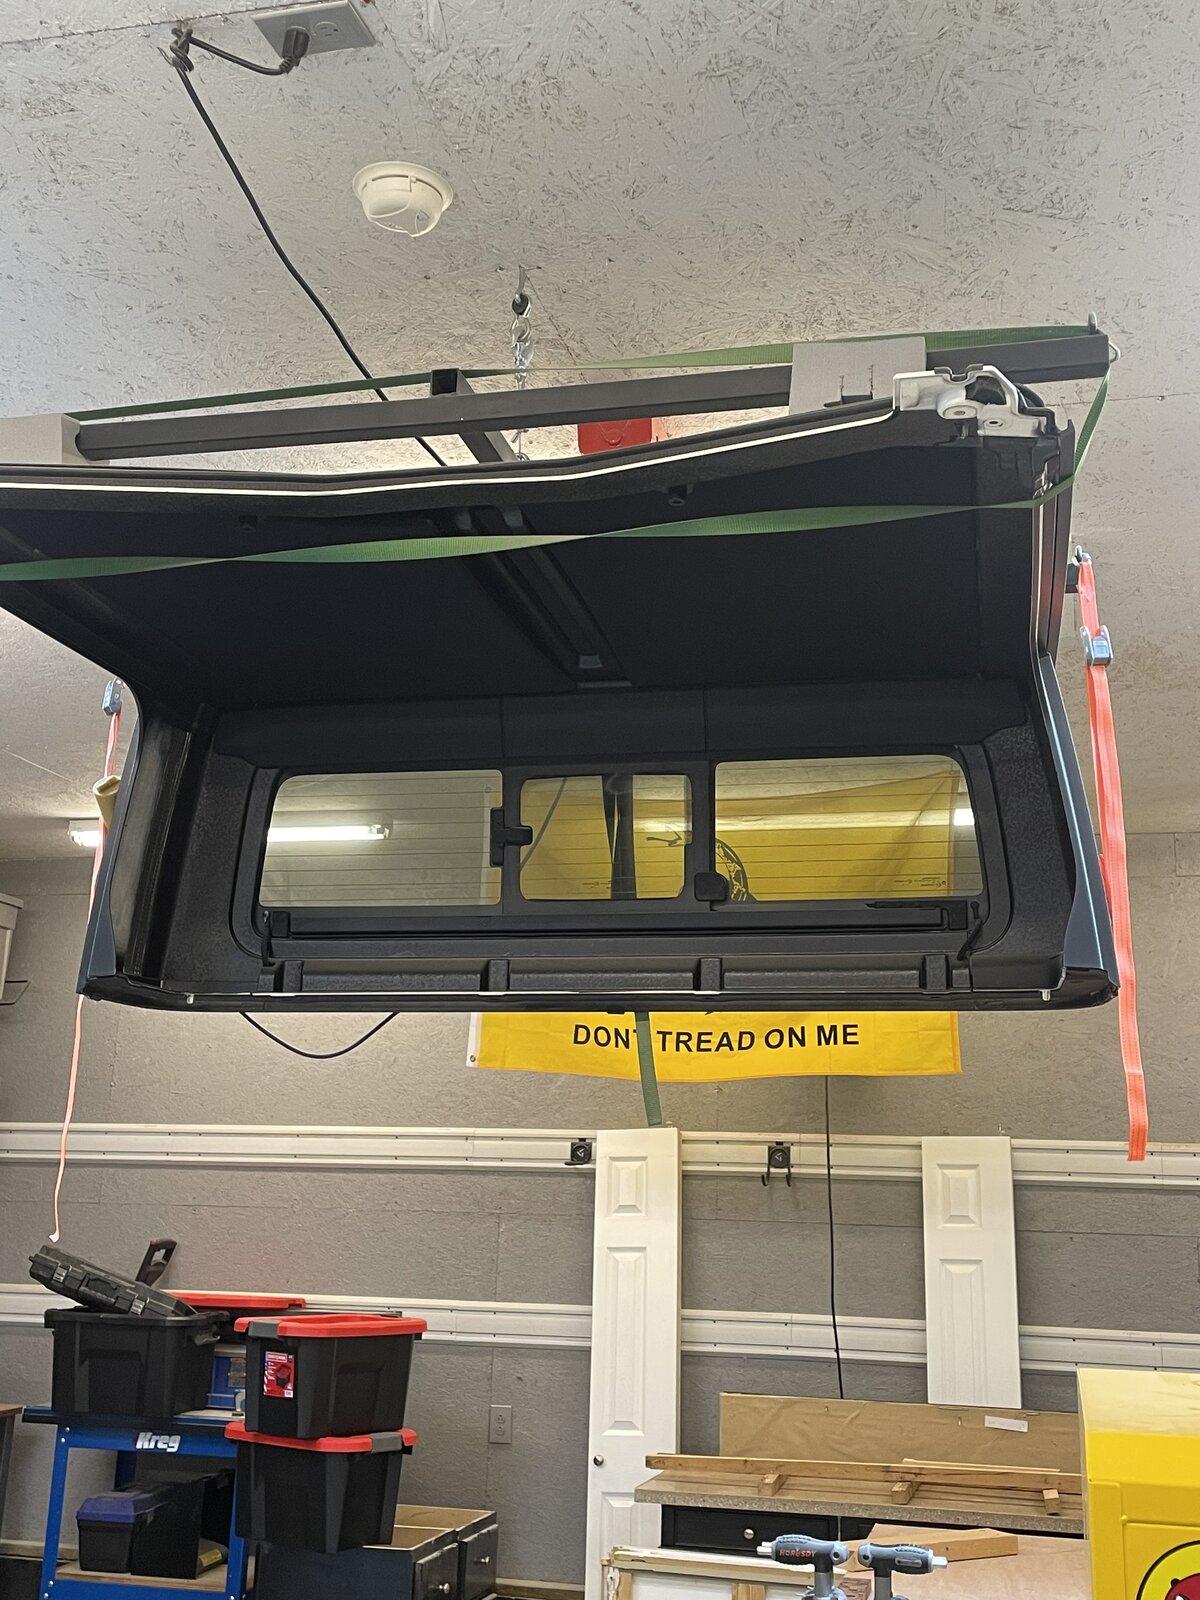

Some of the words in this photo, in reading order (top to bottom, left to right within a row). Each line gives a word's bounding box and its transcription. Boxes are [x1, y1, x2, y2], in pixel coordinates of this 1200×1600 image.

[573, 1024, 637, 1050] DON
[656, 1030, 755, 1053] TREAD
[764, 1026, 806, 1049] ON
[817, 1024, 859, 1046] ME
[136, 1432, 181, 1452] Kreg
